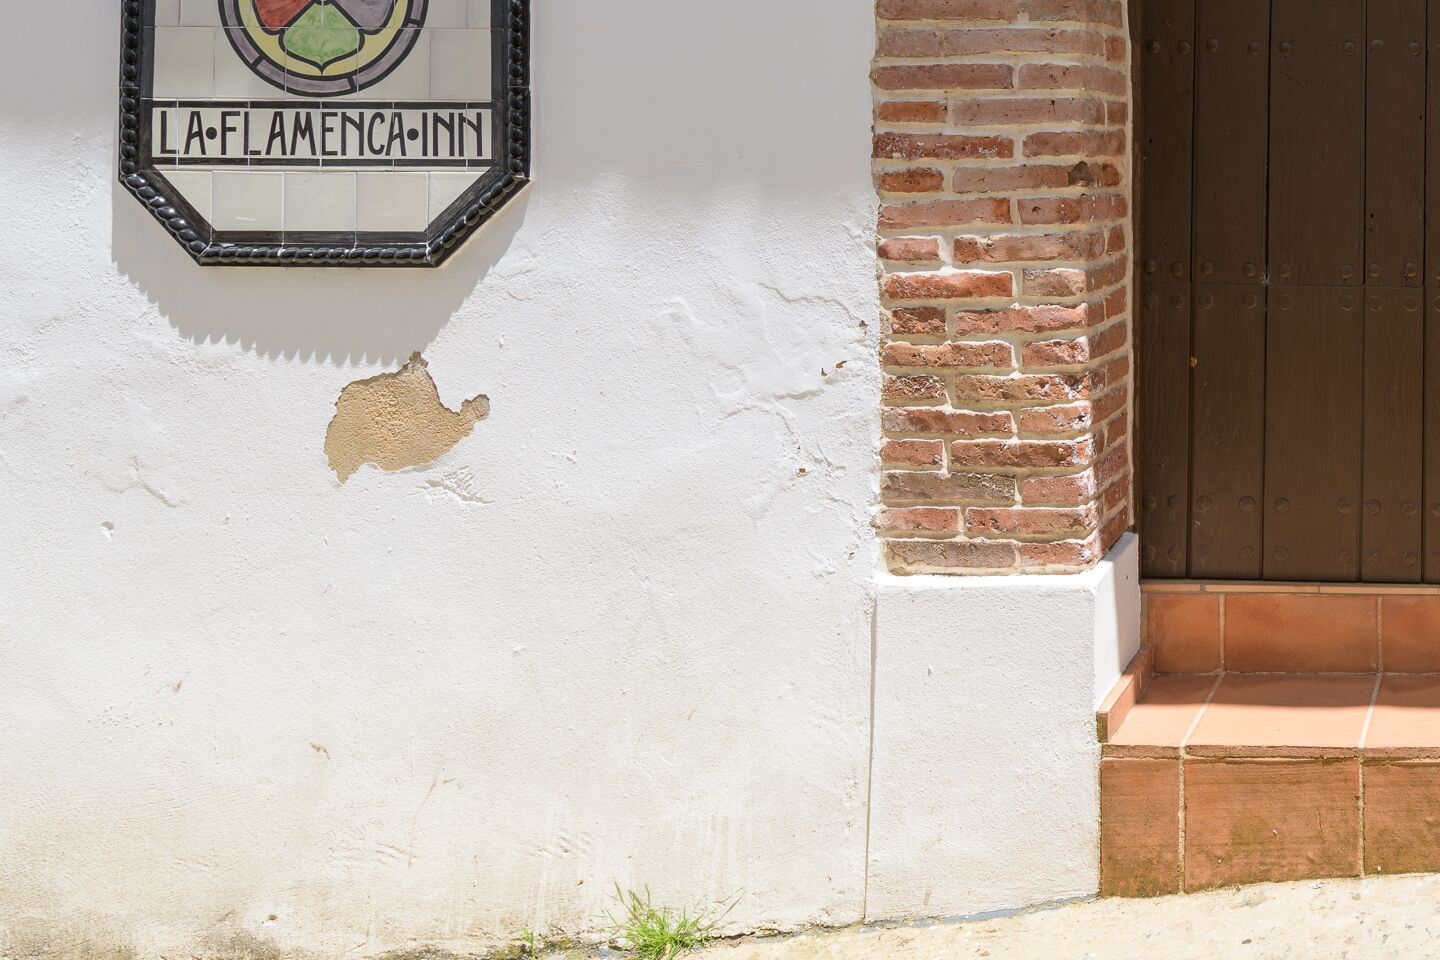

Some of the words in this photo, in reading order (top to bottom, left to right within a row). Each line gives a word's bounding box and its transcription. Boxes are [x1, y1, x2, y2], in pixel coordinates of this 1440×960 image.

[160, 111, 207, 156] LA
[222, 111, 404, 156] FLAMENCA
[421, 112, 484, 157] INN
